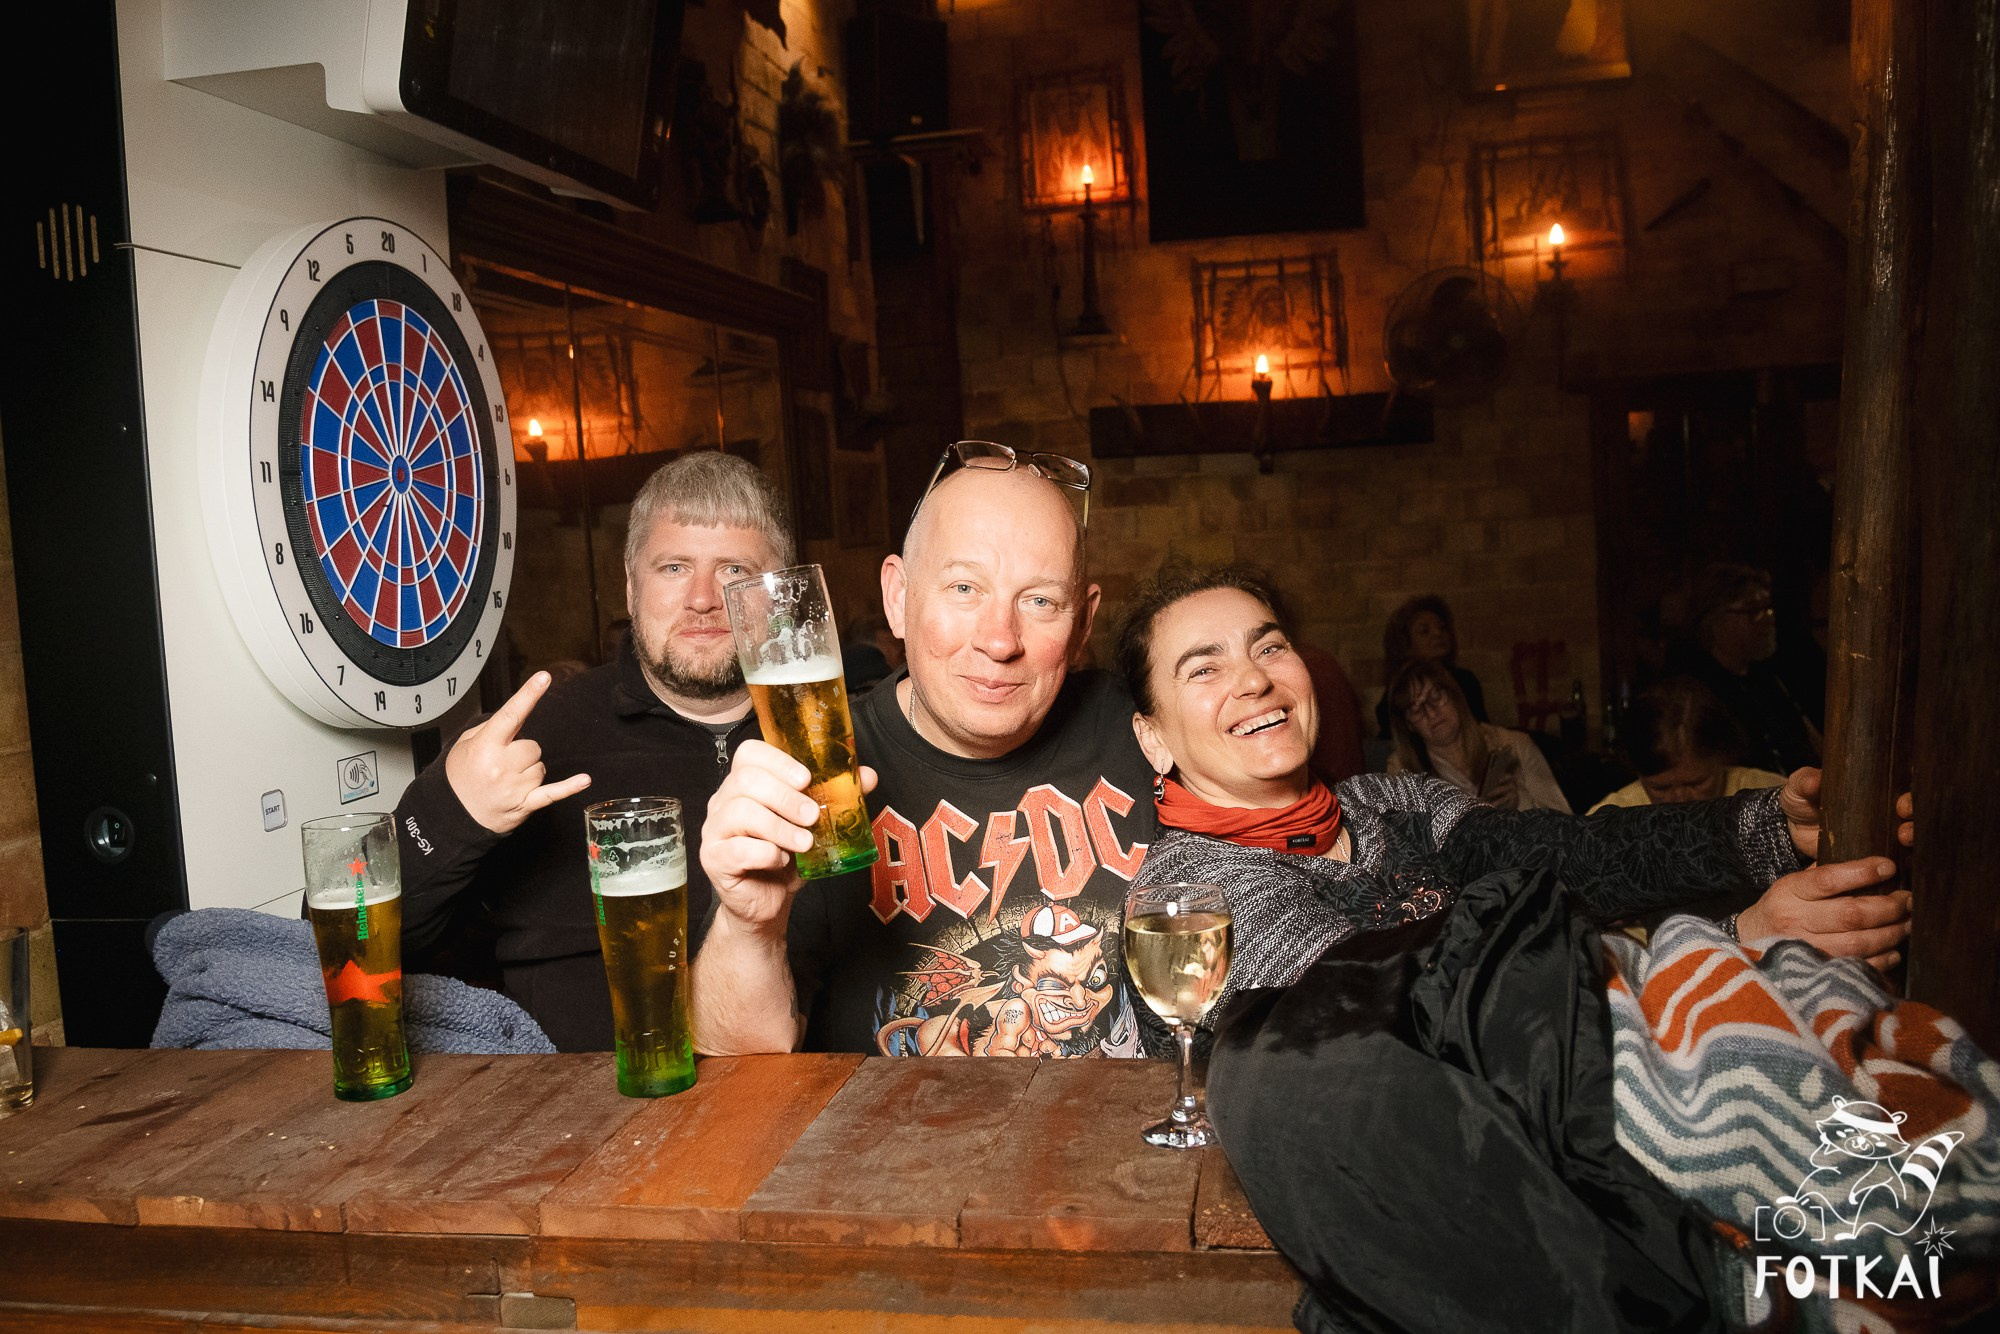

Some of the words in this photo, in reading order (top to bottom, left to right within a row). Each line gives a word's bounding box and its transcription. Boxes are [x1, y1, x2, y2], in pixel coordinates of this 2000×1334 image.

[345, 233, 354, 255] 5
[380, 230, 396, 254] 20
[306, 258, 321, 283] 12
[421, 253, 427, 273] 1
[451, 292, 462, 313] 18
[279, 309, 290, 332] 9
[478, 344, 485, 362] 4
[260, 380, 275, 403] 14
[494, 404, 504, 423] 13
[259, 461, 272, 483] 11
[504, 468, 511, 486] 6
[502, 531, 512, 550] 10
[275, 542, 284, 565] 8
[492, 590, 503, 609] 15
[299, 612, 314, 635] 16
[475, 639, 483, 658] 2
[336, 664, 345, 686] 7
[446, 676, 457, 697] 17
[373, 690, 387, 712] 19
[414, 694, 422, 715] 3
[264, 804, 280, 815] START
[405, 816, 434, 856] KS-300
[354, 881, 369, 941] Heineken
